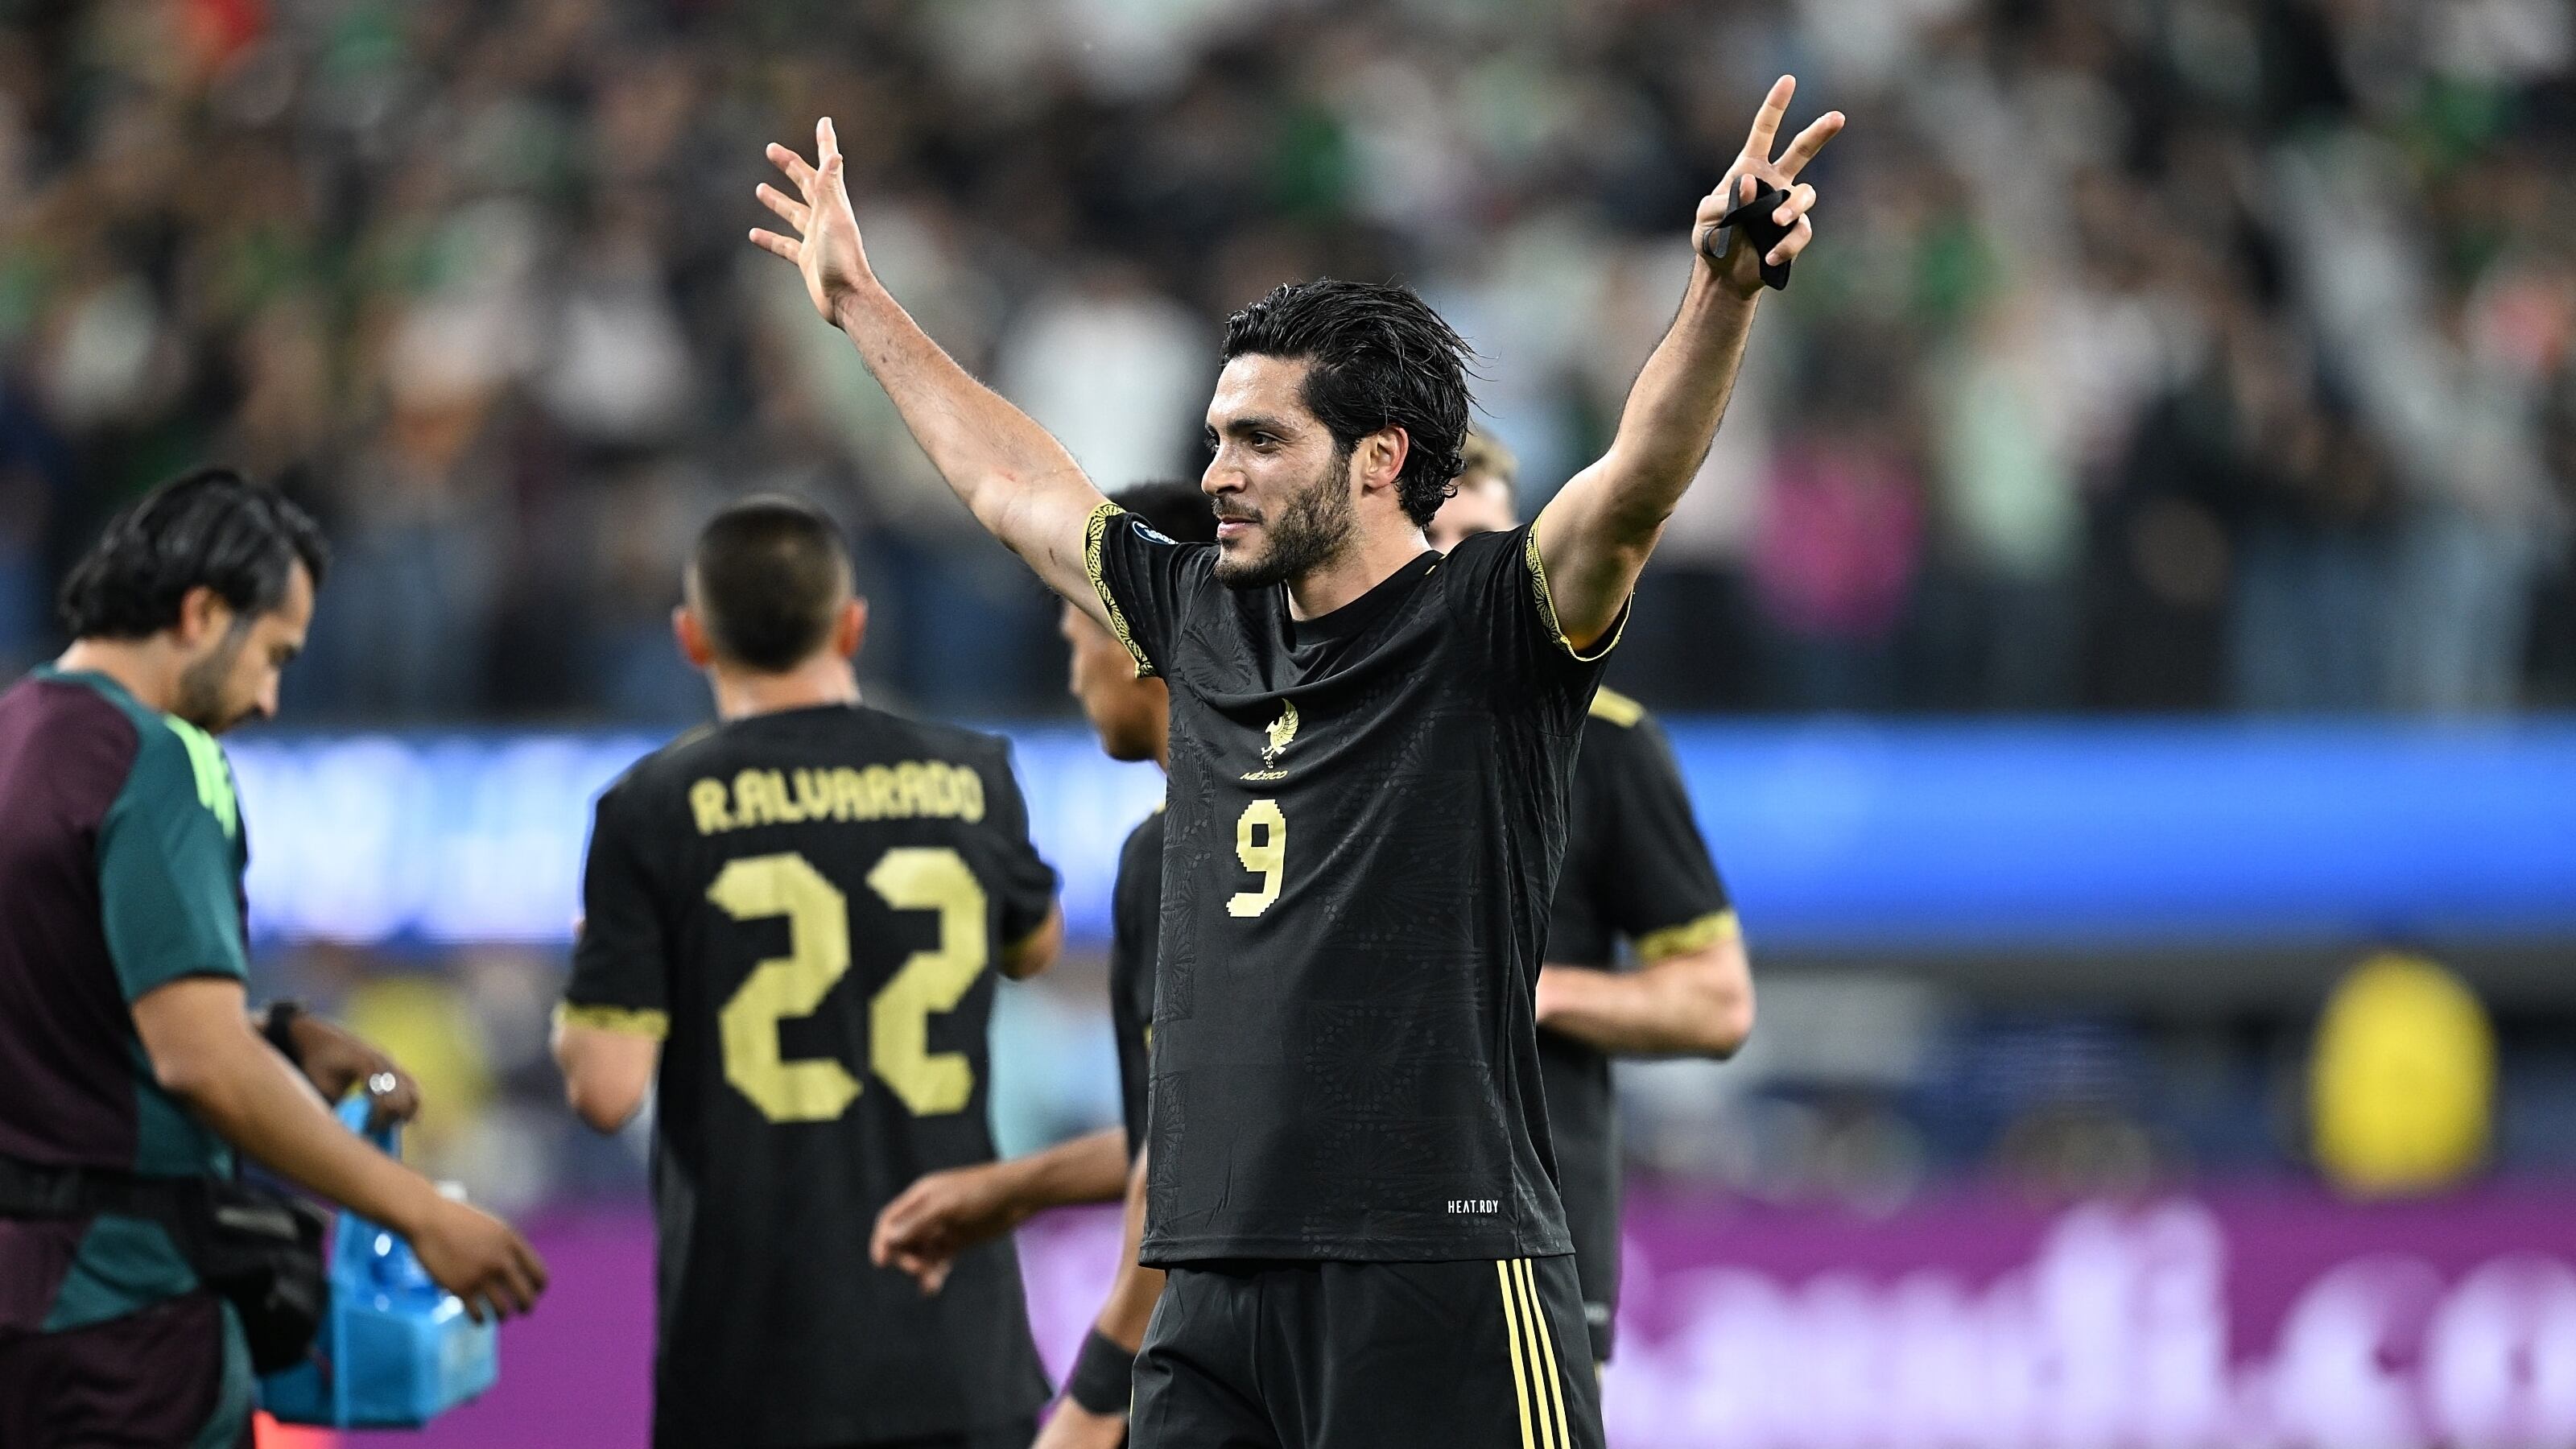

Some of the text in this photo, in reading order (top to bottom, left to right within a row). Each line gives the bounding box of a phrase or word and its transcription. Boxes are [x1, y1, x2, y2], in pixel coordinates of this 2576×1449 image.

[688, 760, 985, 836] R.ALVARADO
[1226, 799, 1286, 918] 9
[704, 846, 989, 1123] 22
[1447, 1199, 1499, 1214] HEAT.RDY
